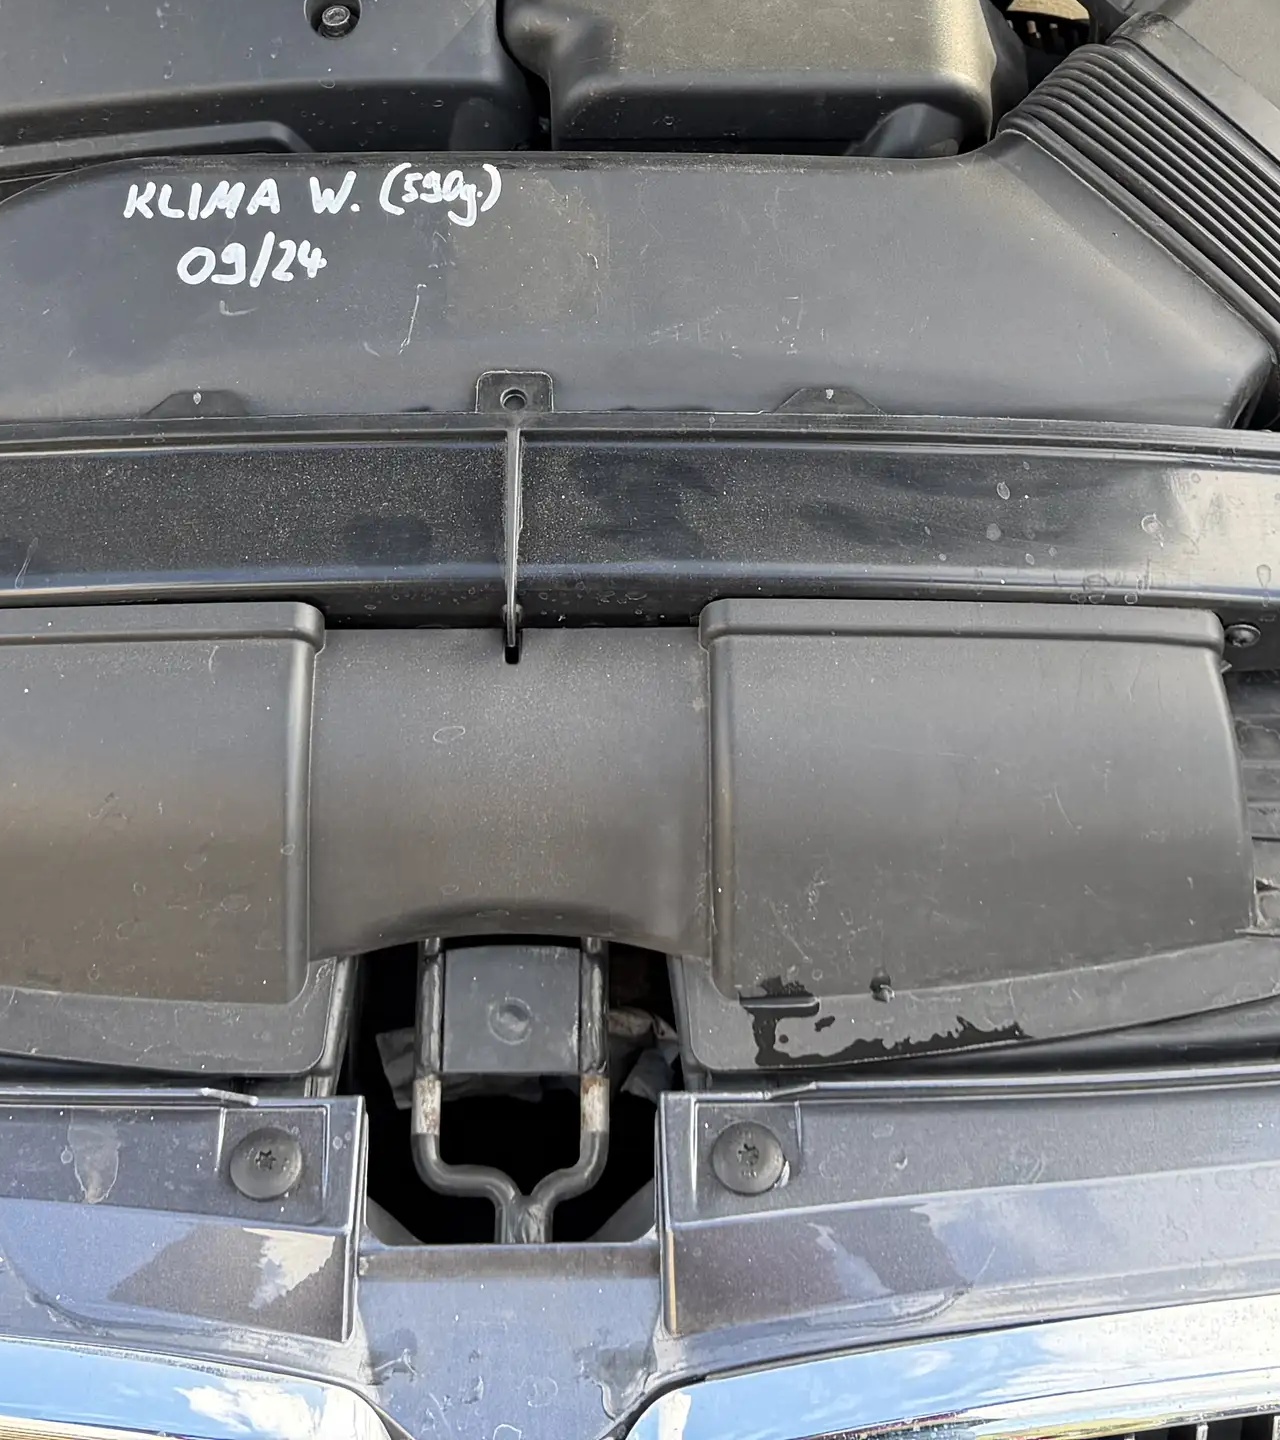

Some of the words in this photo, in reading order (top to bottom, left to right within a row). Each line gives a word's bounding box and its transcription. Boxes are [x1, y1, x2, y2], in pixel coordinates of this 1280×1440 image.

[123, 178, 281, 220] KLIMA
[309, 171, 361, 214] W.
[176, 231, 328, 287] 09/24
